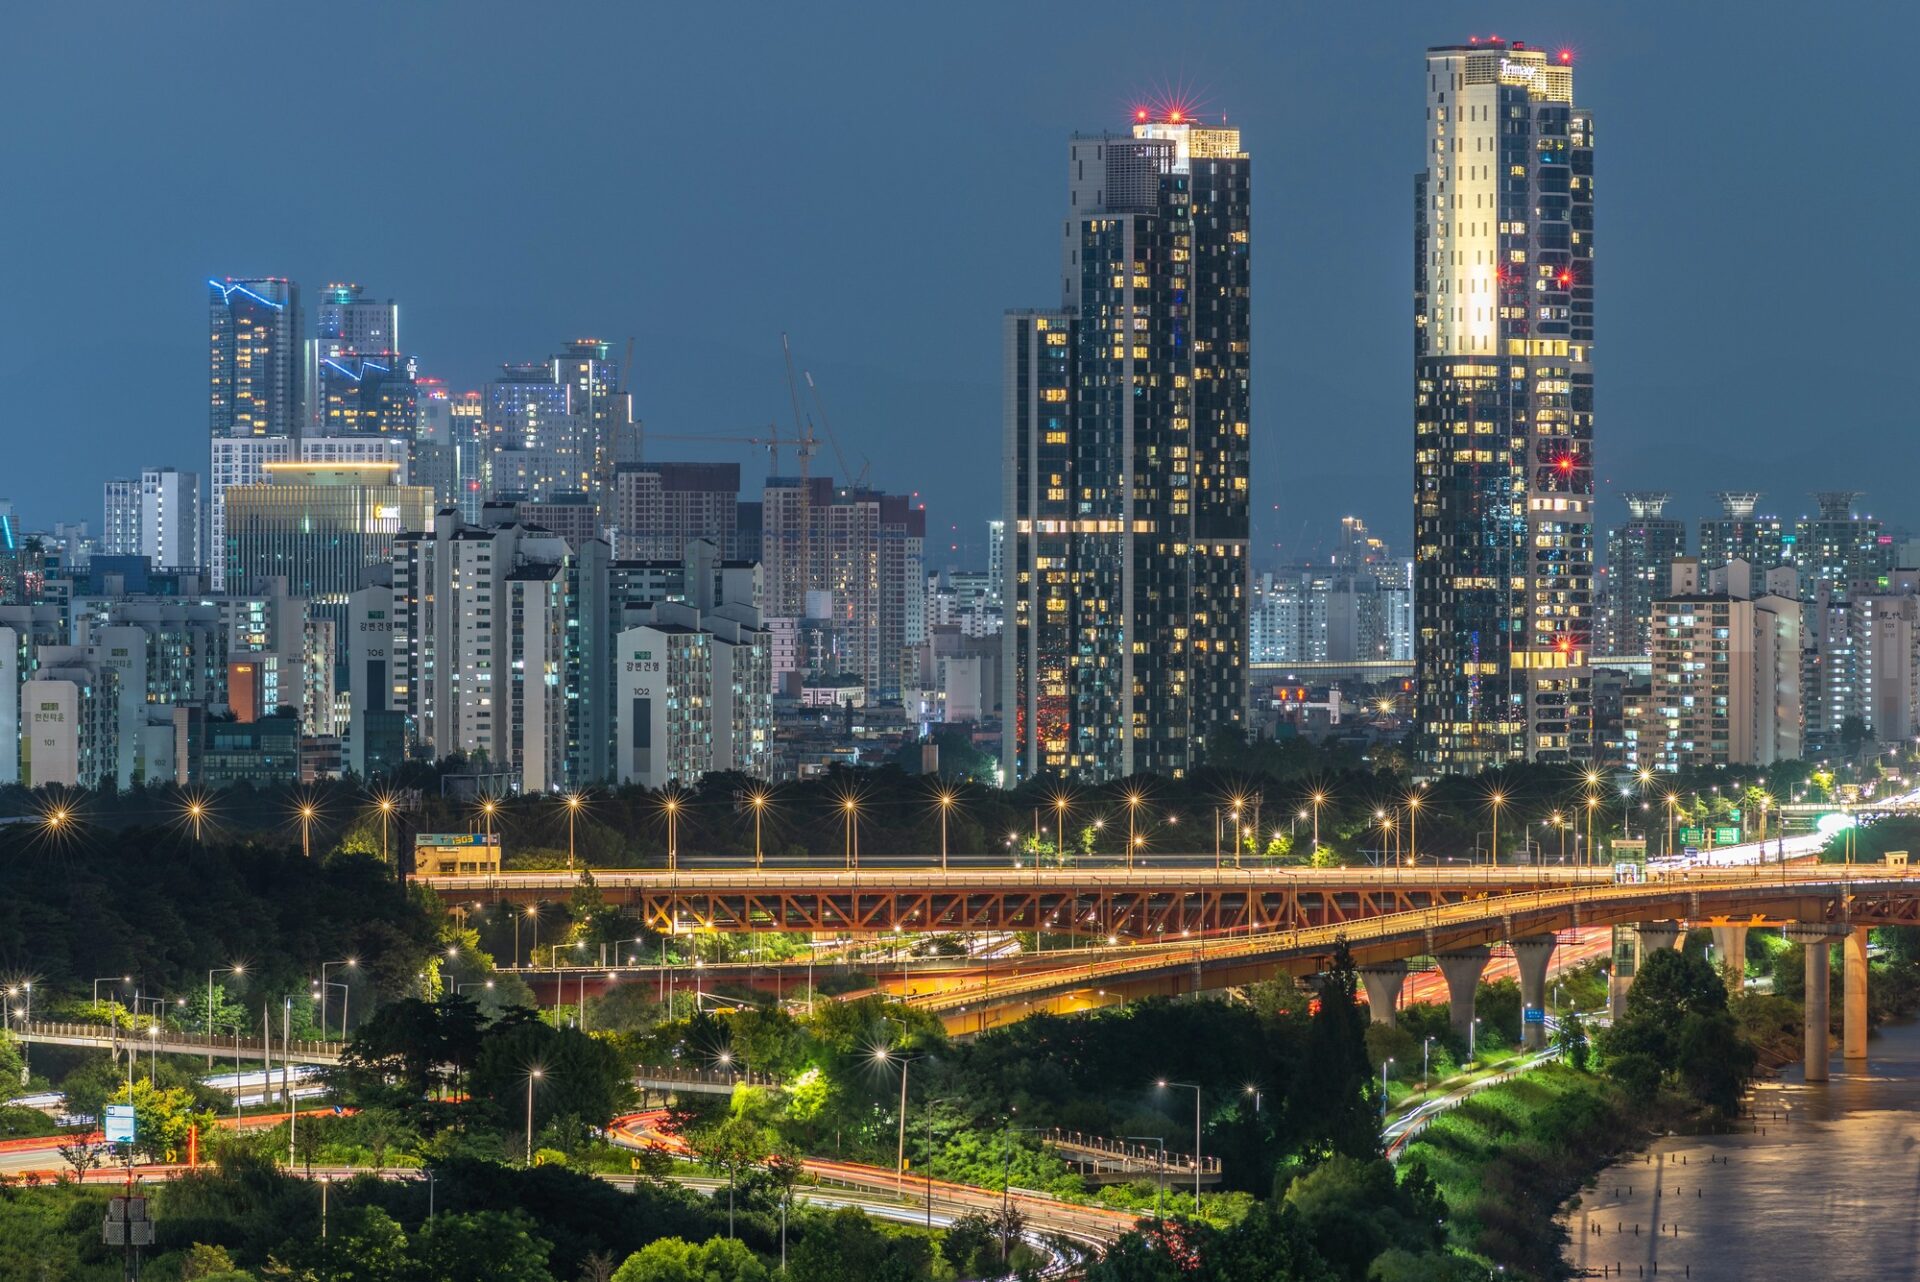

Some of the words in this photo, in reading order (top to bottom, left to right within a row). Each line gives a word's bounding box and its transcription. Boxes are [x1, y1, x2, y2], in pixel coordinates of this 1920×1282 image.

[360, 621, 393, 632] 강변건영
[626, 661, 660, 672] 강변건영
[633, 687, 650, 696] 102
